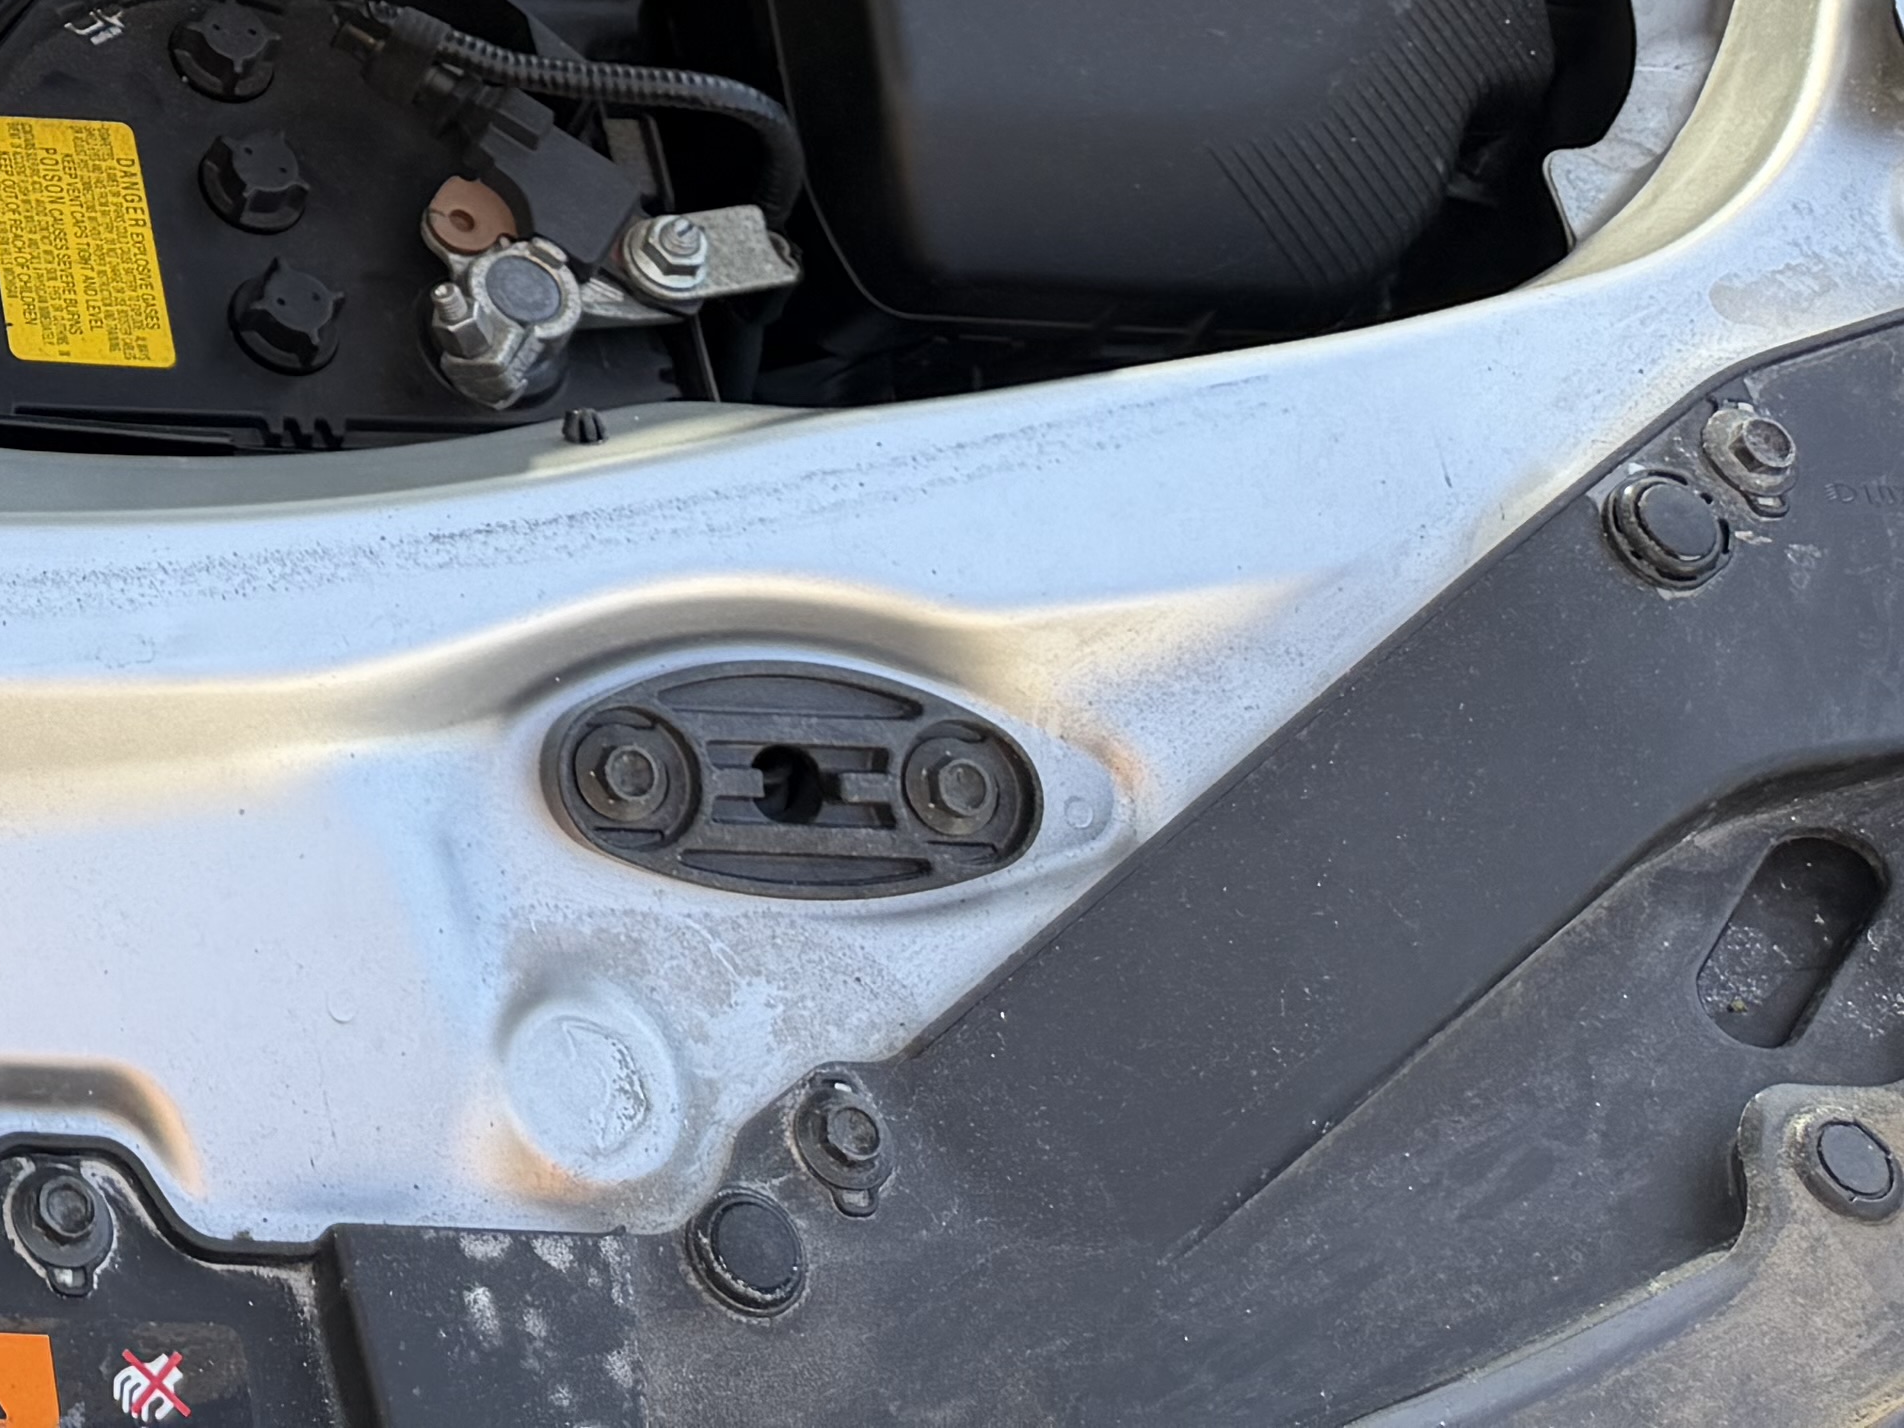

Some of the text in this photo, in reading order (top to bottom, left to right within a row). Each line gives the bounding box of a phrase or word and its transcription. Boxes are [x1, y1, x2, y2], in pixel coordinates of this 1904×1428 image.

[1, 178, 18, 199] OUT
[5, 201, 20, 215] OF
[8, 218, 26, 253] REACH
[37, 146, 83, 335] POISON CAUSES SEVERE BURNS
[60, 152, 103, 332] KEEP VENT CAPS TIGHT AND LEVEL
[116, 157, 161, 329] DANGER EXPLOSIVE GASES
[14, 255, 29, 270] OF
[16, 272, 38, 325] CHILDREN
